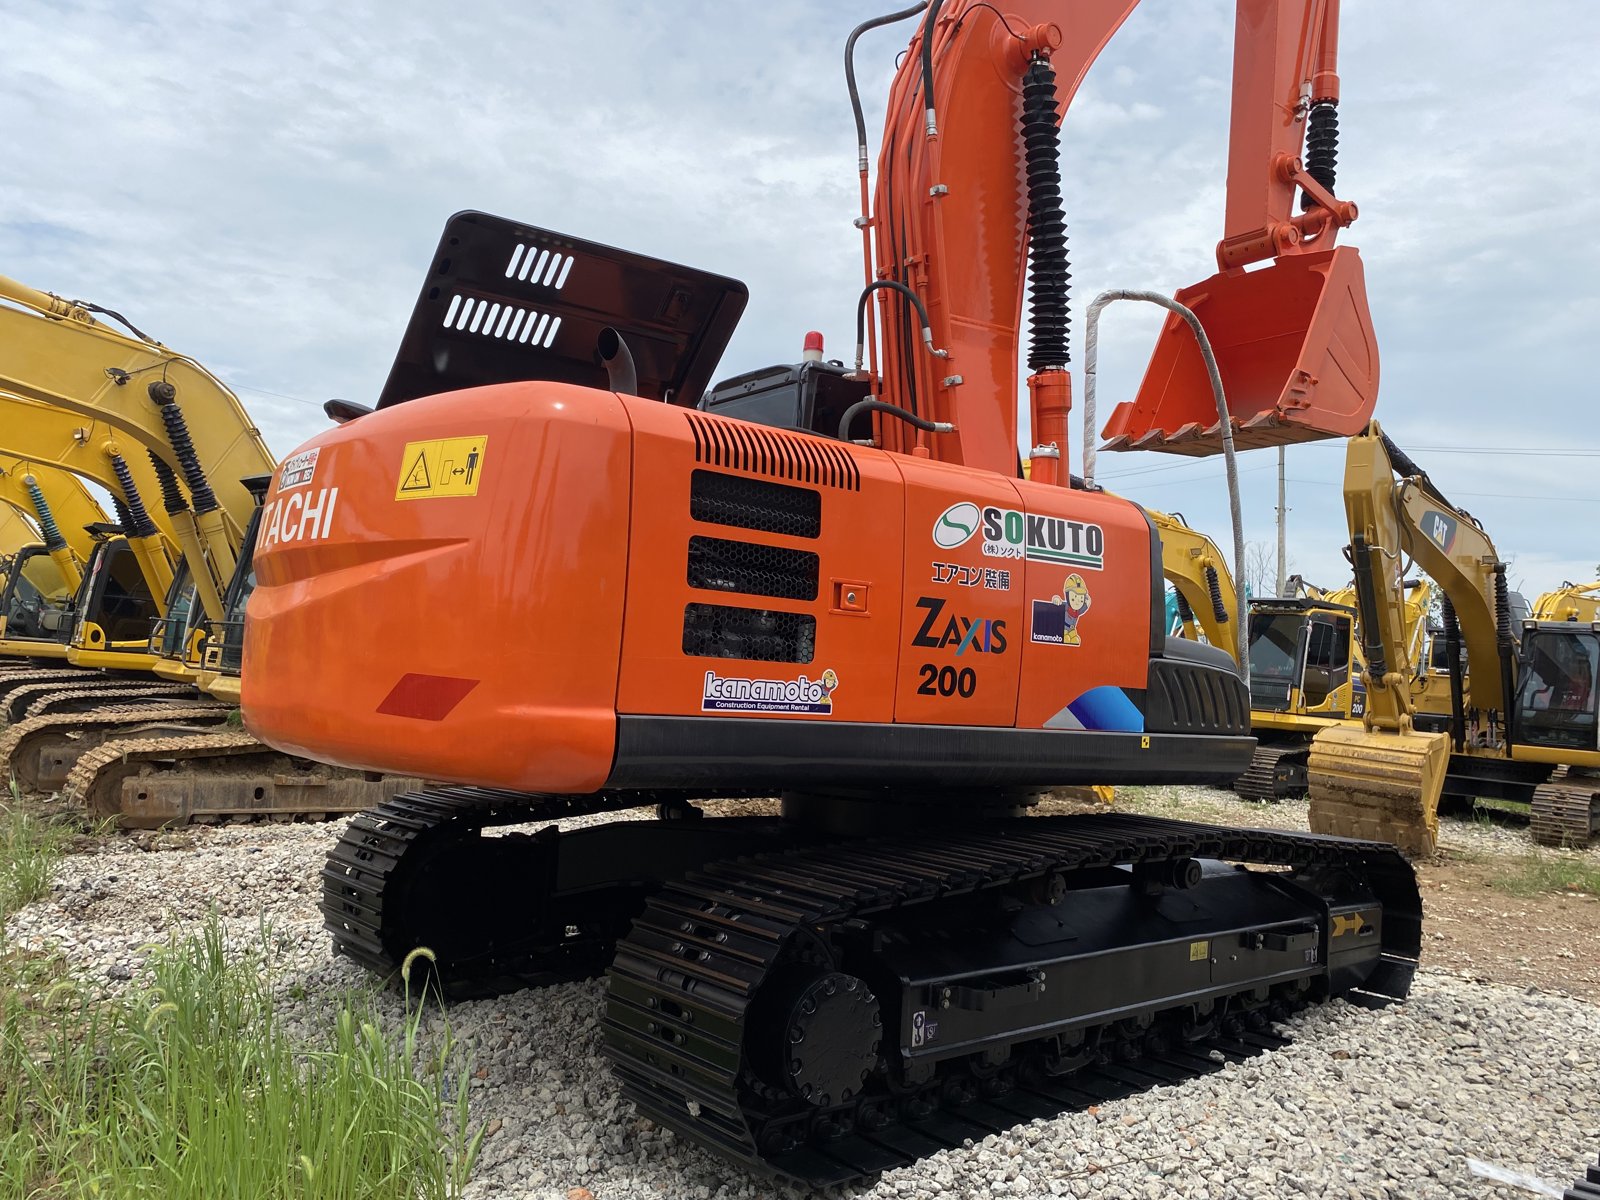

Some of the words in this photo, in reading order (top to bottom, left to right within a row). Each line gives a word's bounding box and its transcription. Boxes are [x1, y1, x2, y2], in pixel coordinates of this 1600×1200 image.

[983, 507, 1103, 556] SOKUTO
[1433, 514, 1448, 547] CAT
[931, 562, 1010, 590] エアコン装備
[911, 596, 1007, 656] ZAXIS
[1033, 632, 1063, 642] kanamoto
[705, 671, 823, 702] kanamoto
[916, 663, 977, 699] 200
[715, 701, 756, 709] Construction
[757, 702, 790, 711] Equipment
[1352, 703, 1363, 714] 200
